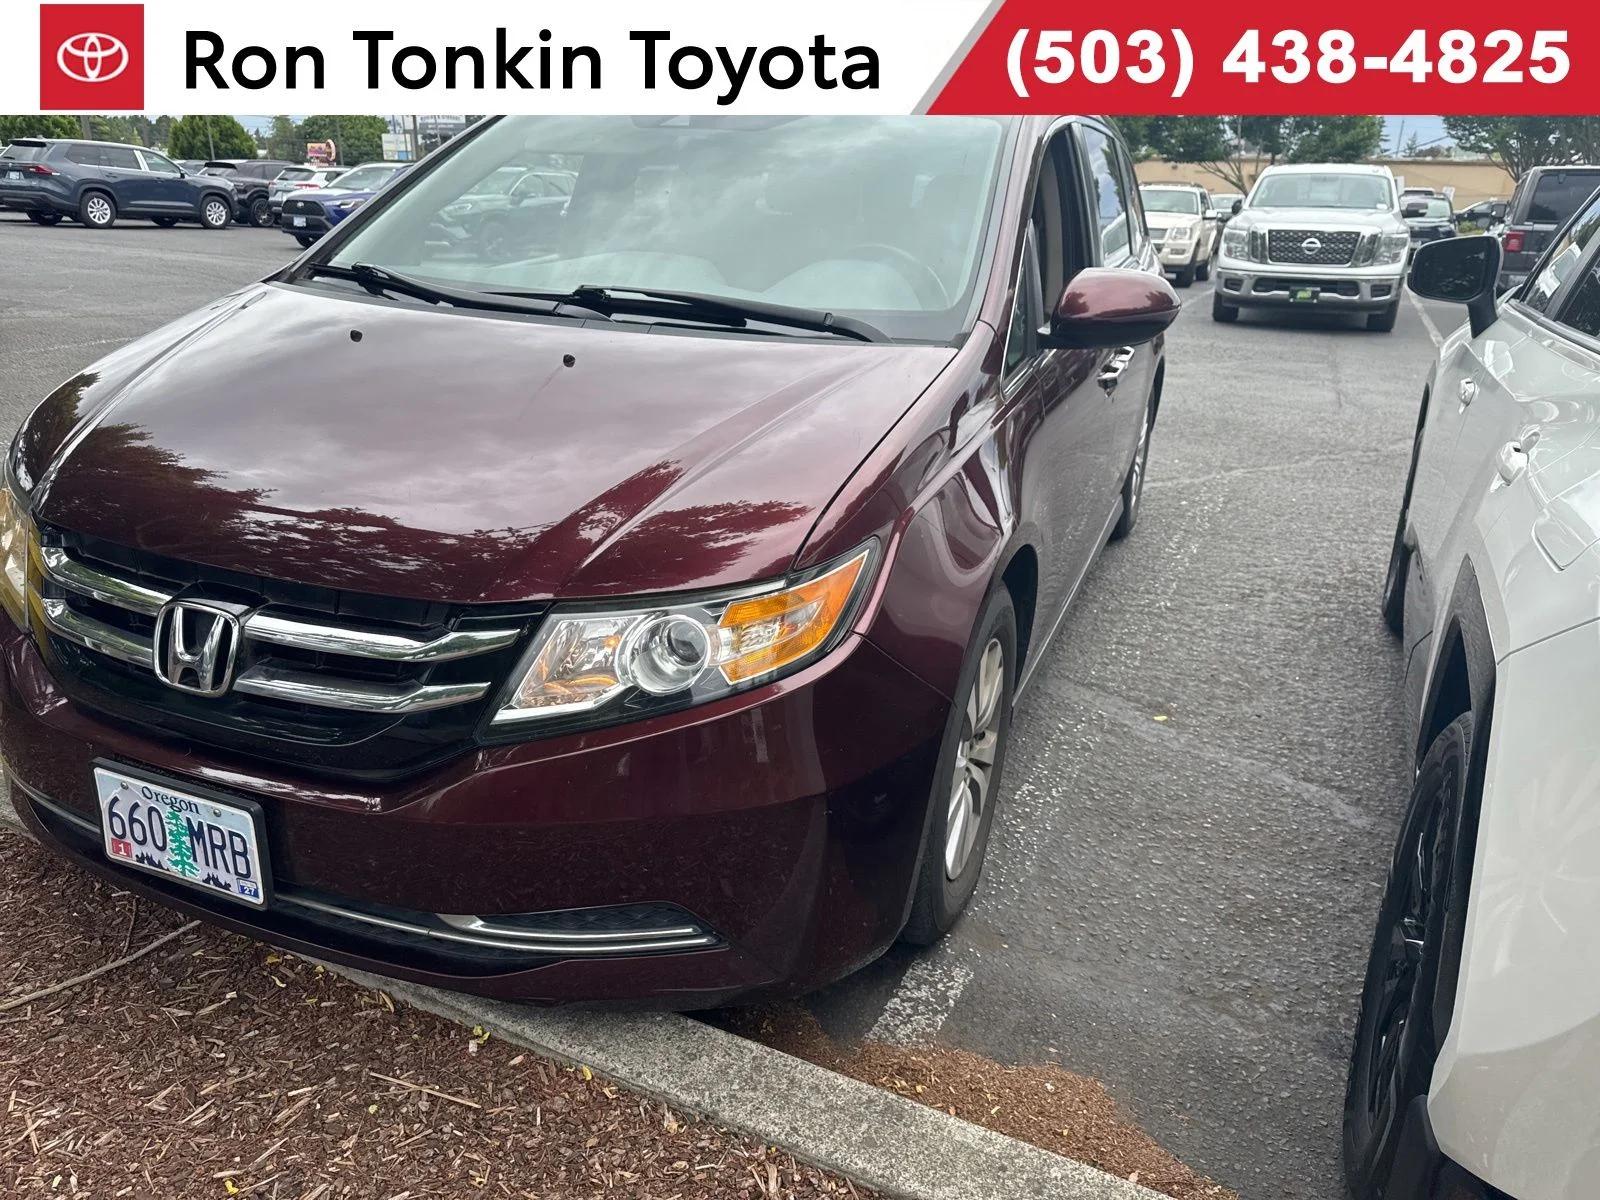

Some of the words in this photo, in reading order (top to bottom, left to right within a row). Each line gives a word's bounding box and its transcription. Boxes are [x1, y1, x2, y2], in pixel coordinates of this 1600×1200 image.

[141, 786, 200, 815] Oregon
[108, 795, 167, 852] 660
[185, 816, 251, 879] MRB
[243, 886, 255, 896] 27
